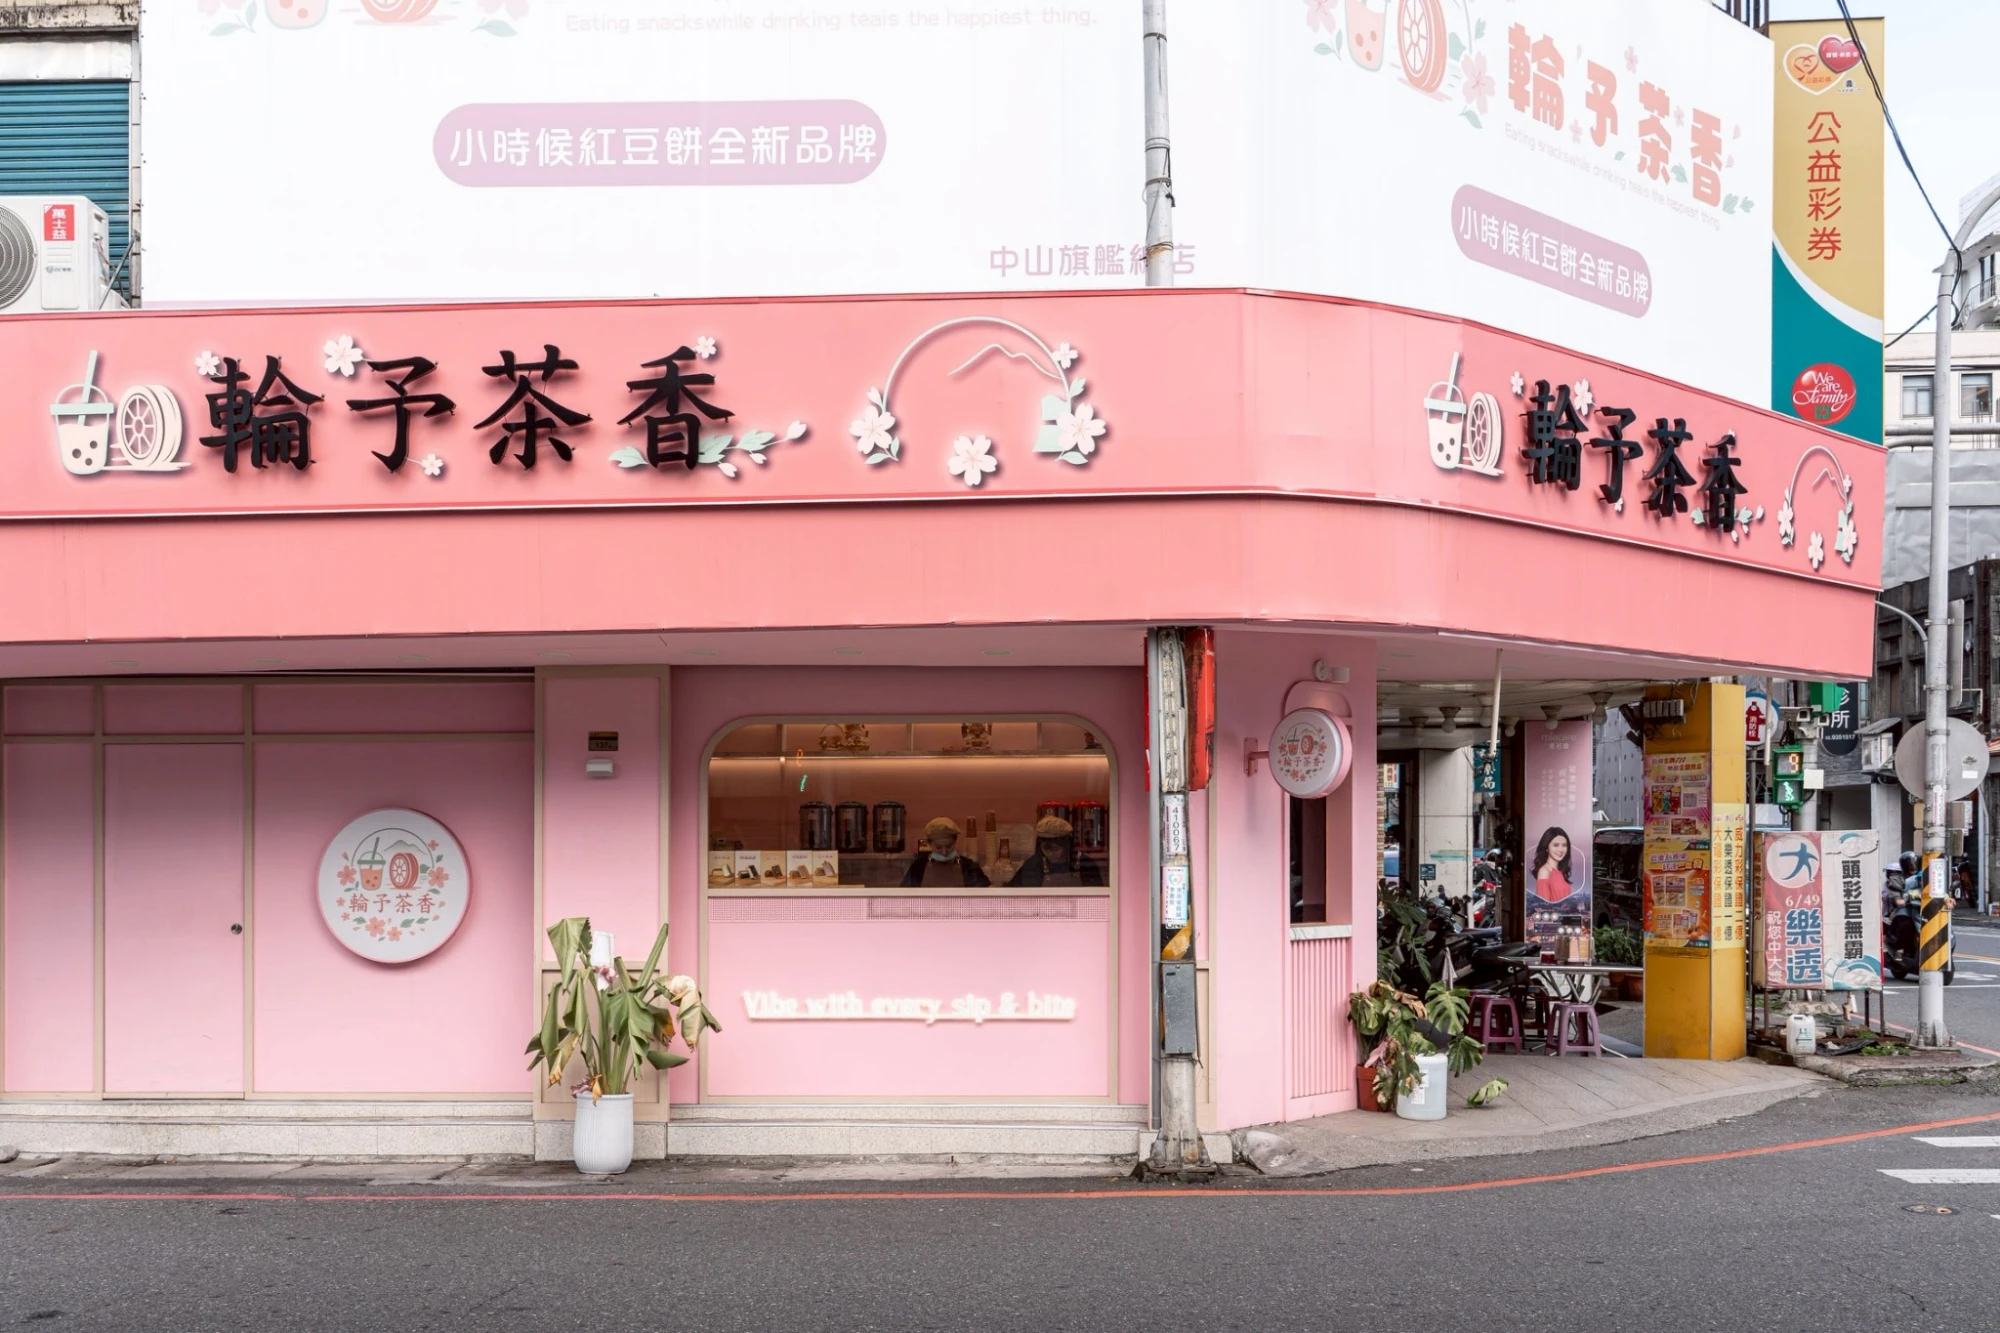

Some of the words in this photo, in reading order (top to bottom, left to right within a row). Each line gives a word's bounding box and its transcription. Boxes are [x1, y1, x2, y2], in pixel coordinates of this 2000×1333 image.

[565, 13, 630, 34] Eating
[761, 9, 841, 31] drinking
[907, 9, 939, 27] the
[946, 8, 1032, 29] happiest
[1041, 6, 1098, 27] thing.
[448, 123, 878, 167] 小時候紅豆餅全新品牌
[1807, 111, 1842, 261] 公益彩券
[52, 208, 67, 240] 萬士益
[1459, 205, 1649, 305] 小時候紅豆餅全新品牌
[1810, 371, 1834, 384] We
[1821, 382, 1840, 393] are
[1793, 383, 1856, 412] Family
[1788, 753, 1799, 773] 9
[1723, 826, 1733, 942] 大樂透保證一億
[1734, 826, 1744, 941] 威力彩保證二億
[1785, 894, 1821, 908] 6/49
[1841, 859, 1864, 960] 頭彩巨無霸
[1785, 908, 1823, 985] 樂透
[742, 990, 799, 1018] Vibe
[804, 991, 864, 1018] with
[870, 996, 942, 1024] every
[950, 993, 992, 1023] sip
[998, 991, 1020, 1017] &
[1026, 990, 1077, 1018] bite
